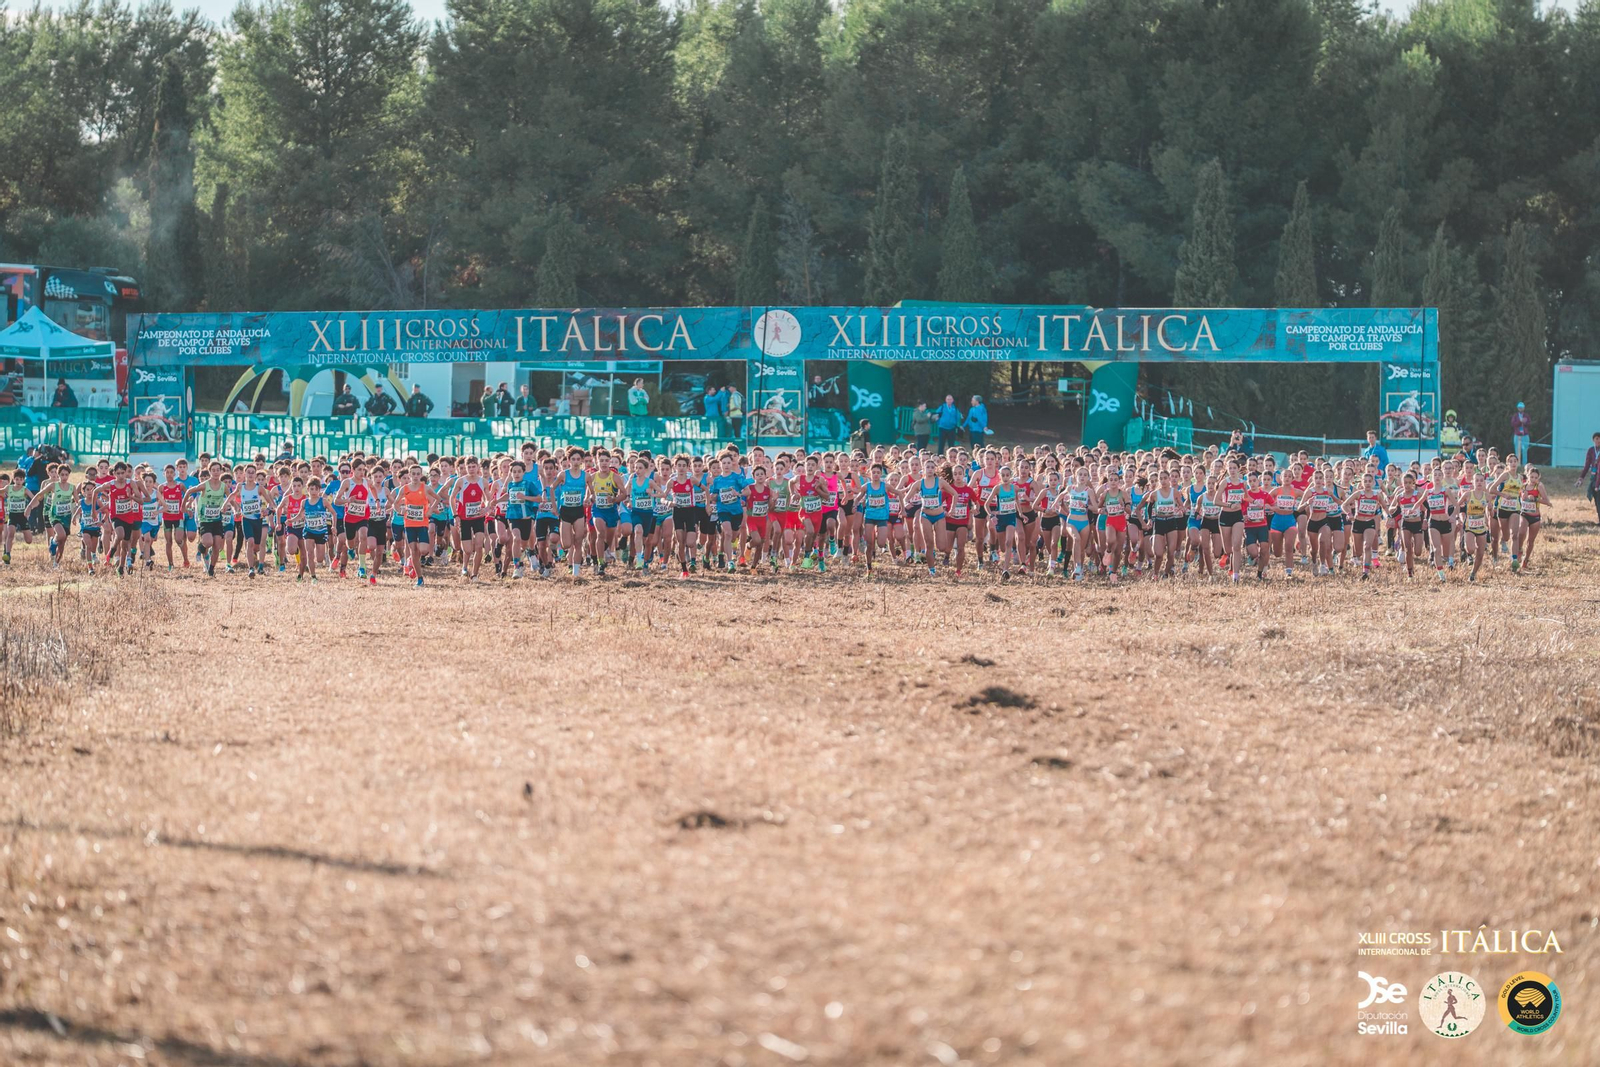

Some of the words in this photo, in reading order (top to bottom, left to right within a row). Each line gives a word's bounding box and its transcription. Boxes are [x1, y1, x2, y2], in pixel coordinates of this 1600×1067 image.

[406, 318, 480, 338] CROSS
[514, 308, 697, 352] ITÁLICA
[828, 315, 924, 347] XLIII
[927, 315, 1002, 335] CROSS
[1037, 308, 1221, 352] ITÁLICA
[1286, 325, 1352, 335] CAMPEONATO
[1353, 326, 1365, 334] DE
[1367, 324, 1423, 334] ANDALUCÍA
[138, 330, 201, 340] CAMPEONATO
[202, 330, 214, 338] DE
[216, 328, 271, 338] ANDALUCÍA
[308, 318, 404, 352] XLIII
[1307, 334, 1319, 342] DE
[1321, 334, 1356, 342] CAMPO
[1357, 334, 1366, 342] A
[158, 338, 170, 347] DE
[171, 338, 205, 347] CAMPO
[207, 338, 215, 346] A
[406, 338, 509, 350] INTERNACIONAL
[927, 336, 1030, 348] INTERNACIONAL
[1328, 342, 1347, 351] POR
[1349, 342, 1383, 351] CLUBES
[178, 346, 197, 355] POR
[199, 346, 232, 355] CLUBES
[828, 349, 919, 359] INTERNATIONAL
[921, 349, 956, 359] CROSS
[957, 349, 1011, 360] COUNTRY
[308, 352, 398, 364] INTERNATIONAL
[400, 352, 435, 362] CROSS
[436, 351, 490, 361] COUNTRY
